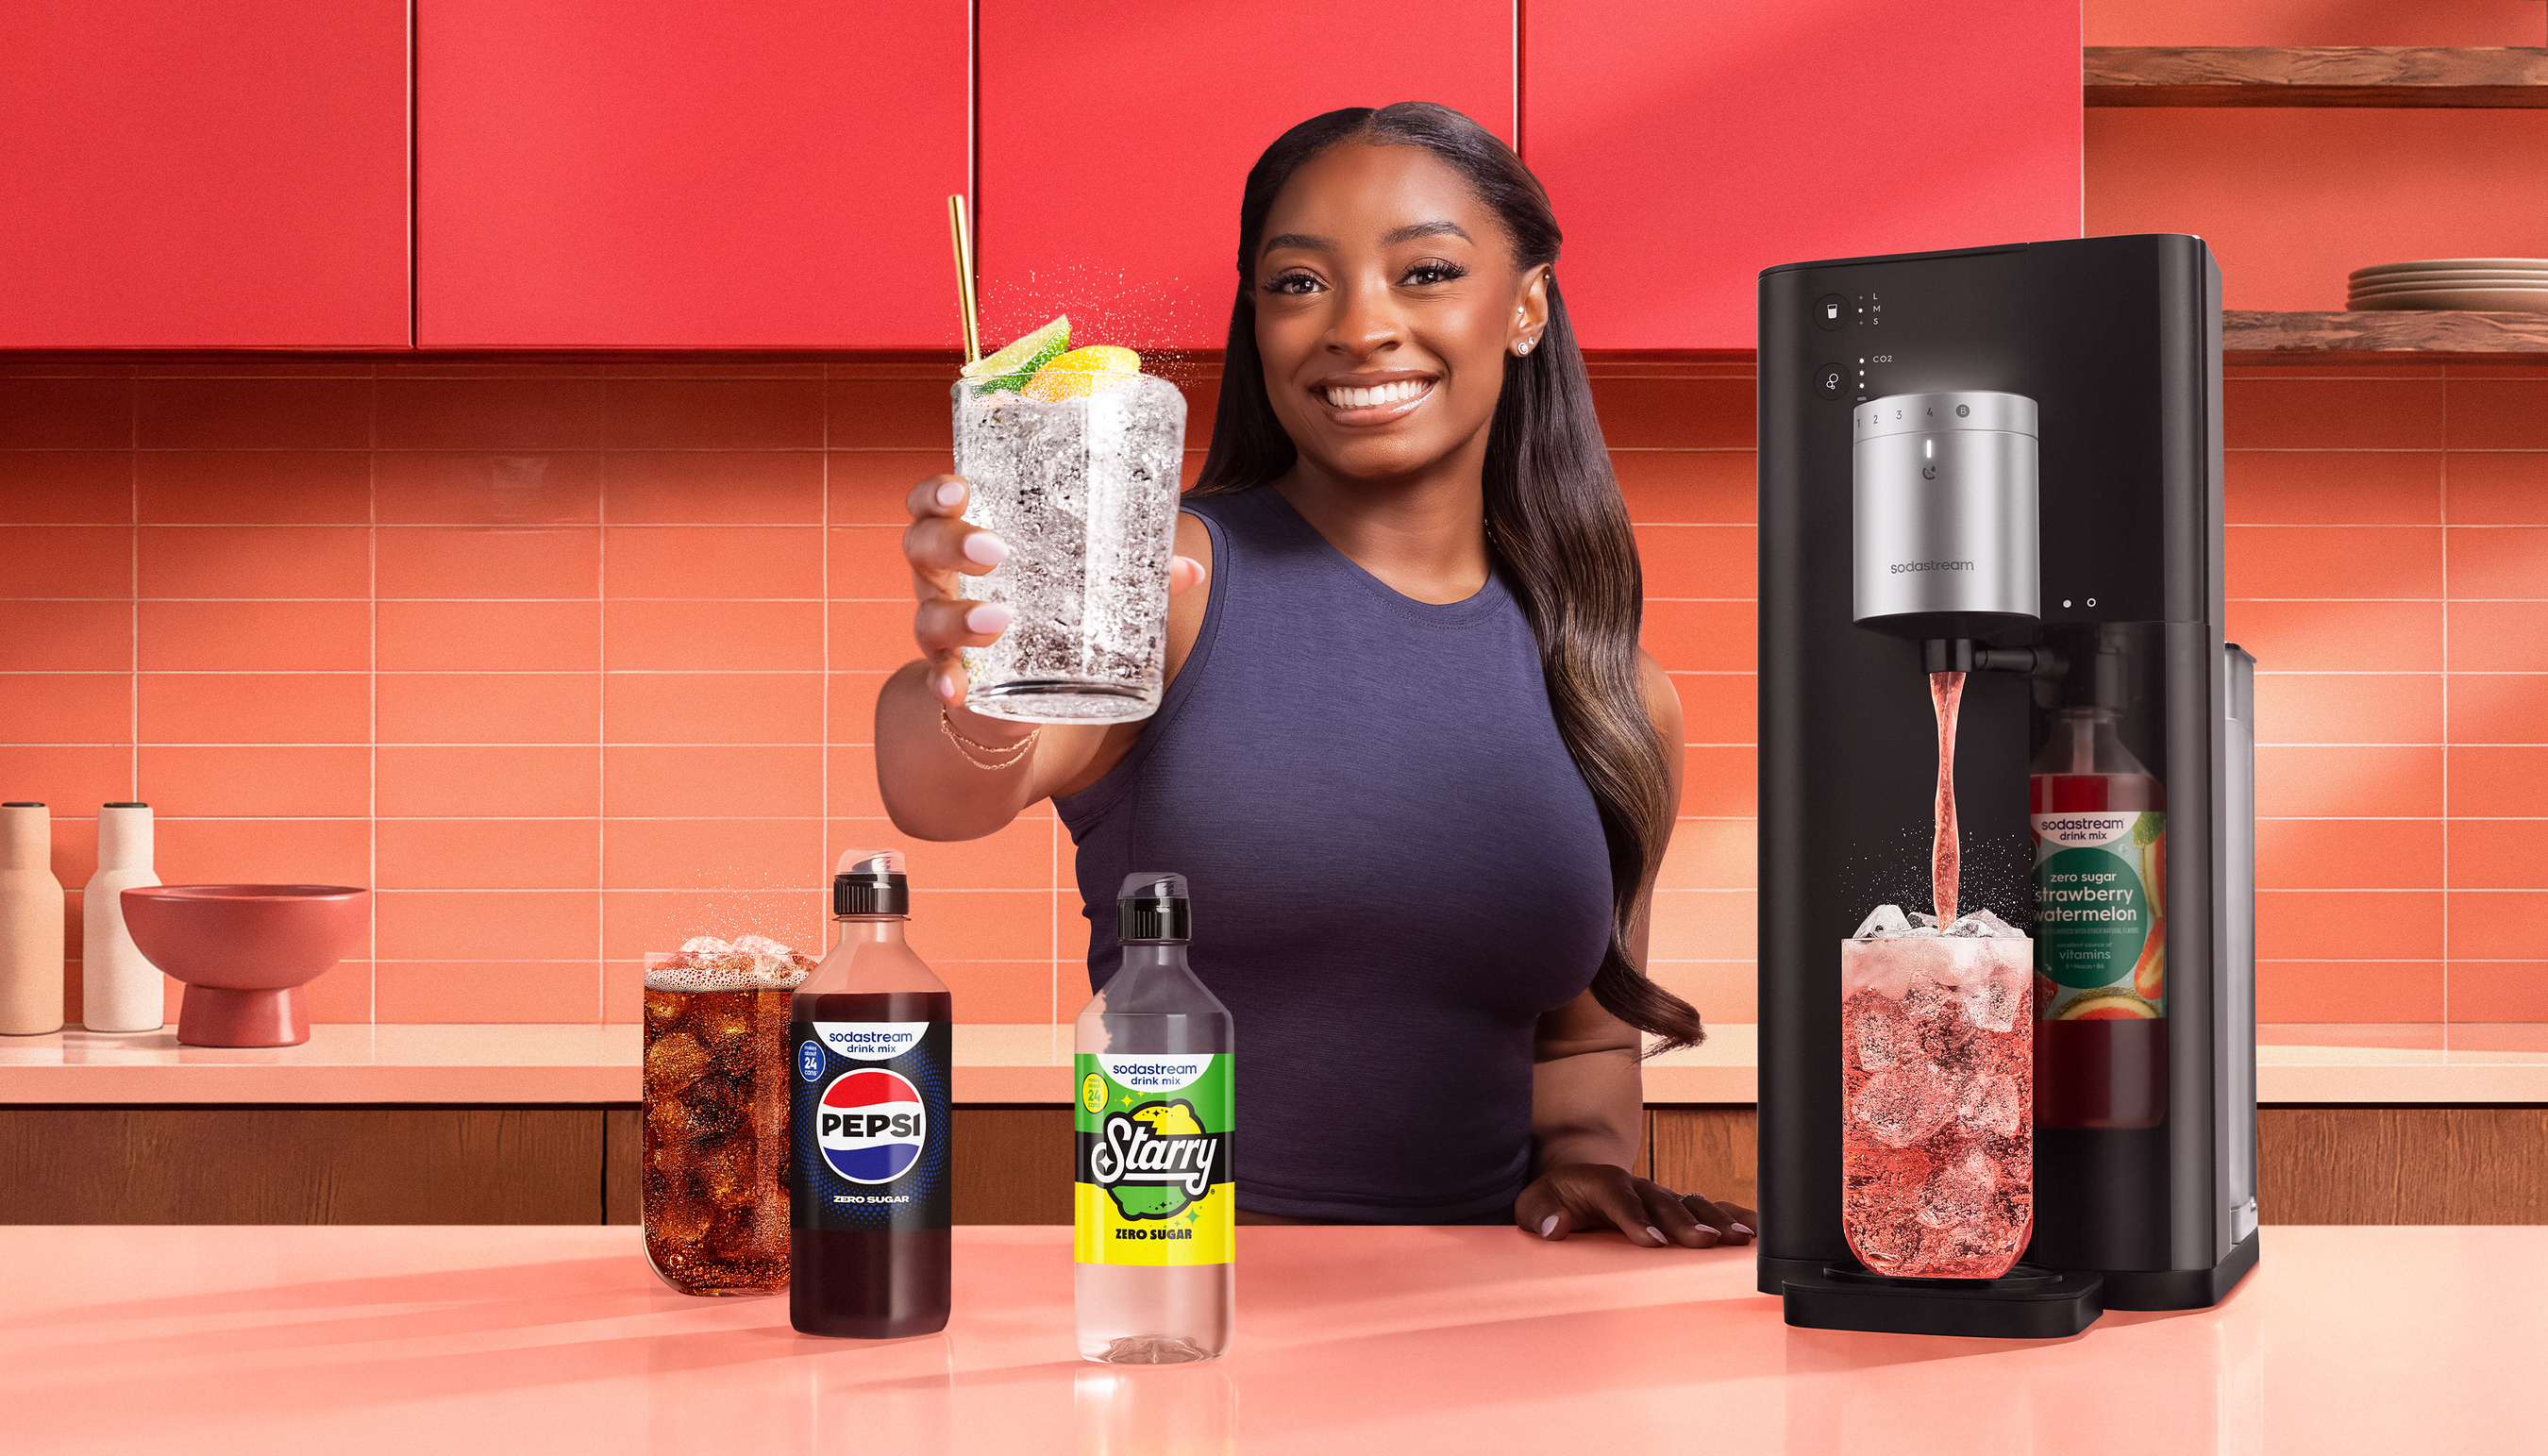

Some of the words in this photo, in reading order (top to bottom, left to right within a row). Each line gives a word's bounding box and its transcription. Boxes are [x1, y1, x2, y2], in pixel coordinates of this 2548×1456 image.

[1857, 418, 1861, 428] 1
[1873, 415, 1878, 424] 2
[1896, 410, 1902, 419] 3
[1927, 408, 1933, 417] 4
[1890, 560, 1974, 574] sodastream
[2041, 818, 2124, 830] sodastream
[2060, 832, 2086, 840] drink
[2089, 831, 2107, 839] mix
[2050, 874, 2078, 883] zero
[2081, 873, 2117, 884] sugar
[2035, 887, 2133, 904] strawberry
[2033, 906, 2137, 921] watermelon
[2059, 949, 2111, 959] vitamins
[829, 1032, 912, 1043] sodastream
[847, 1045, 874, 1053] drink
[878, 1045, 896, 1053] mix
[805, 1056, 817, 1070] 24
[1113, 1063, 1197, 1075] sodastream
[1131, 1077, 1158, 1085] drink
[1162, 1077, 1180, 1085] mix
[1088, 1089, 1100, 1102] 24
[822, 1113, 920, 1138] PEPSI
[1091, 1117, 1217, 1196] Starry
[833, 1195, 865, 1203] ZERO
[867, 1195, 909, 1203] SUGAR
[1115, 1229, 1147, 1239] ZERO
[1150, 1229, 1192, 1239] SUGAR
